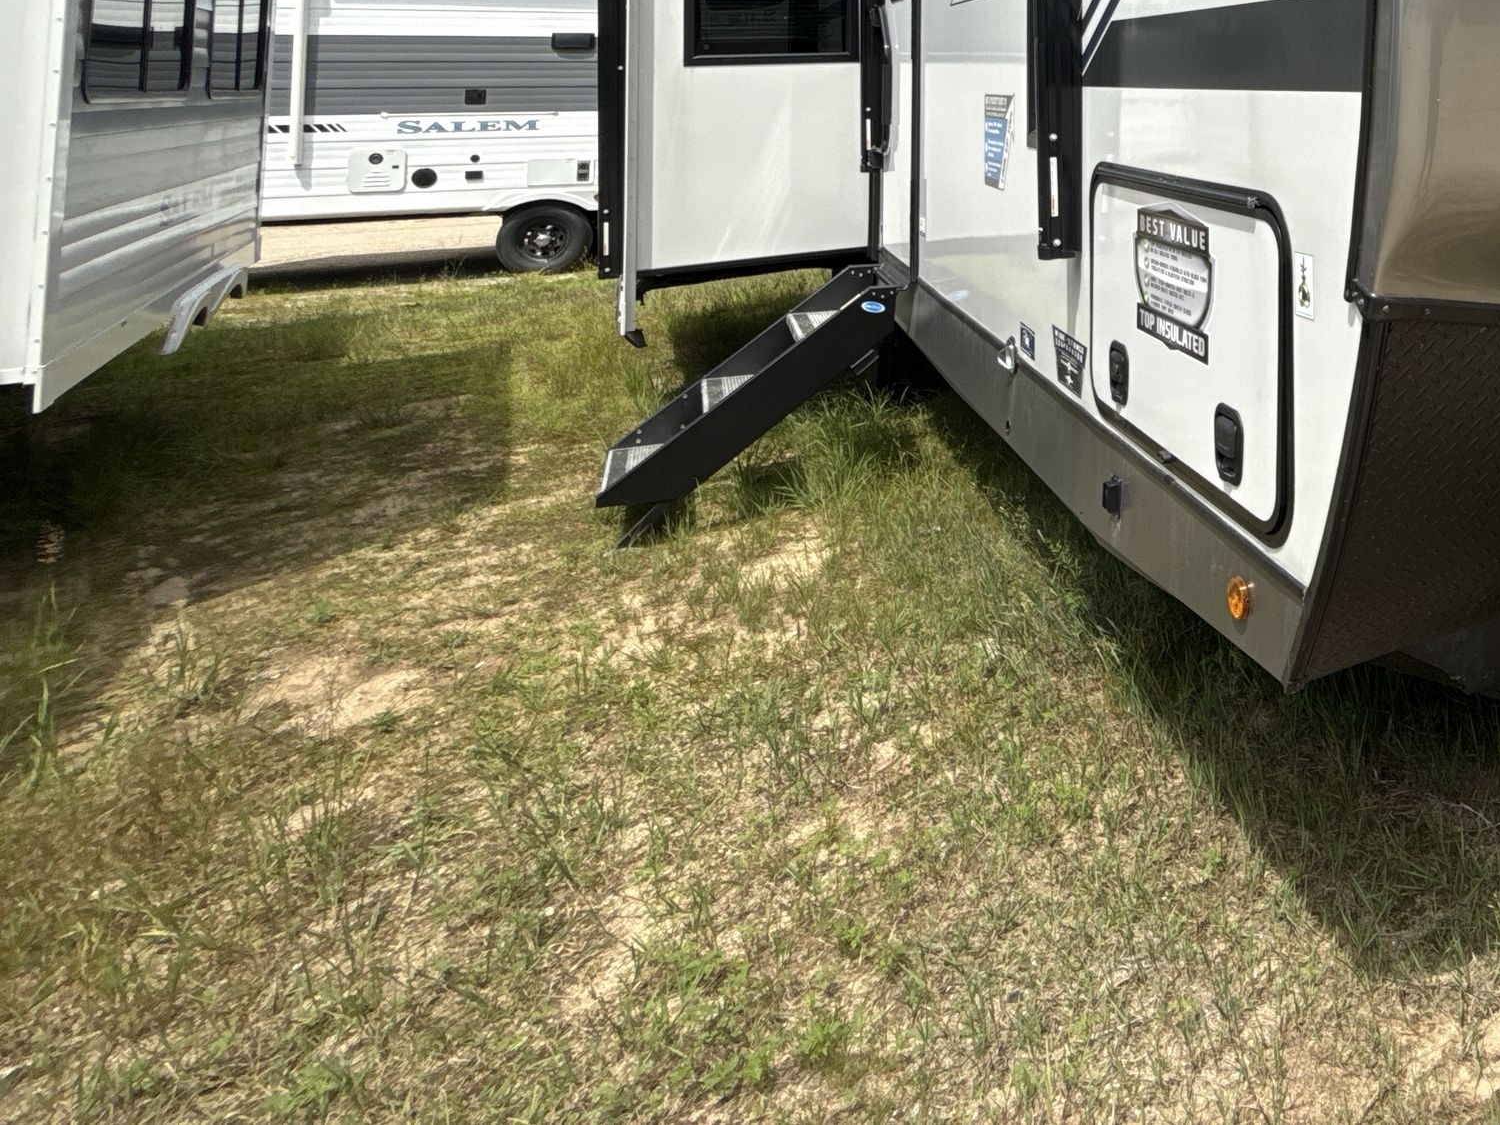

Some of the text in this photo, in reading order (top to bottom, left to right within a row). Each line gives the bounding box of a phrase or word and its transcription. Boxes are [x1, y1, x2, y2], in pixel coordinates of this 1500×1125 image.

[396, 118, 541, 135] SALEM
[1139, 214, 1206, 251] BEST VALUE
[1139, 308, 1206, 357] TOP INSULATED
